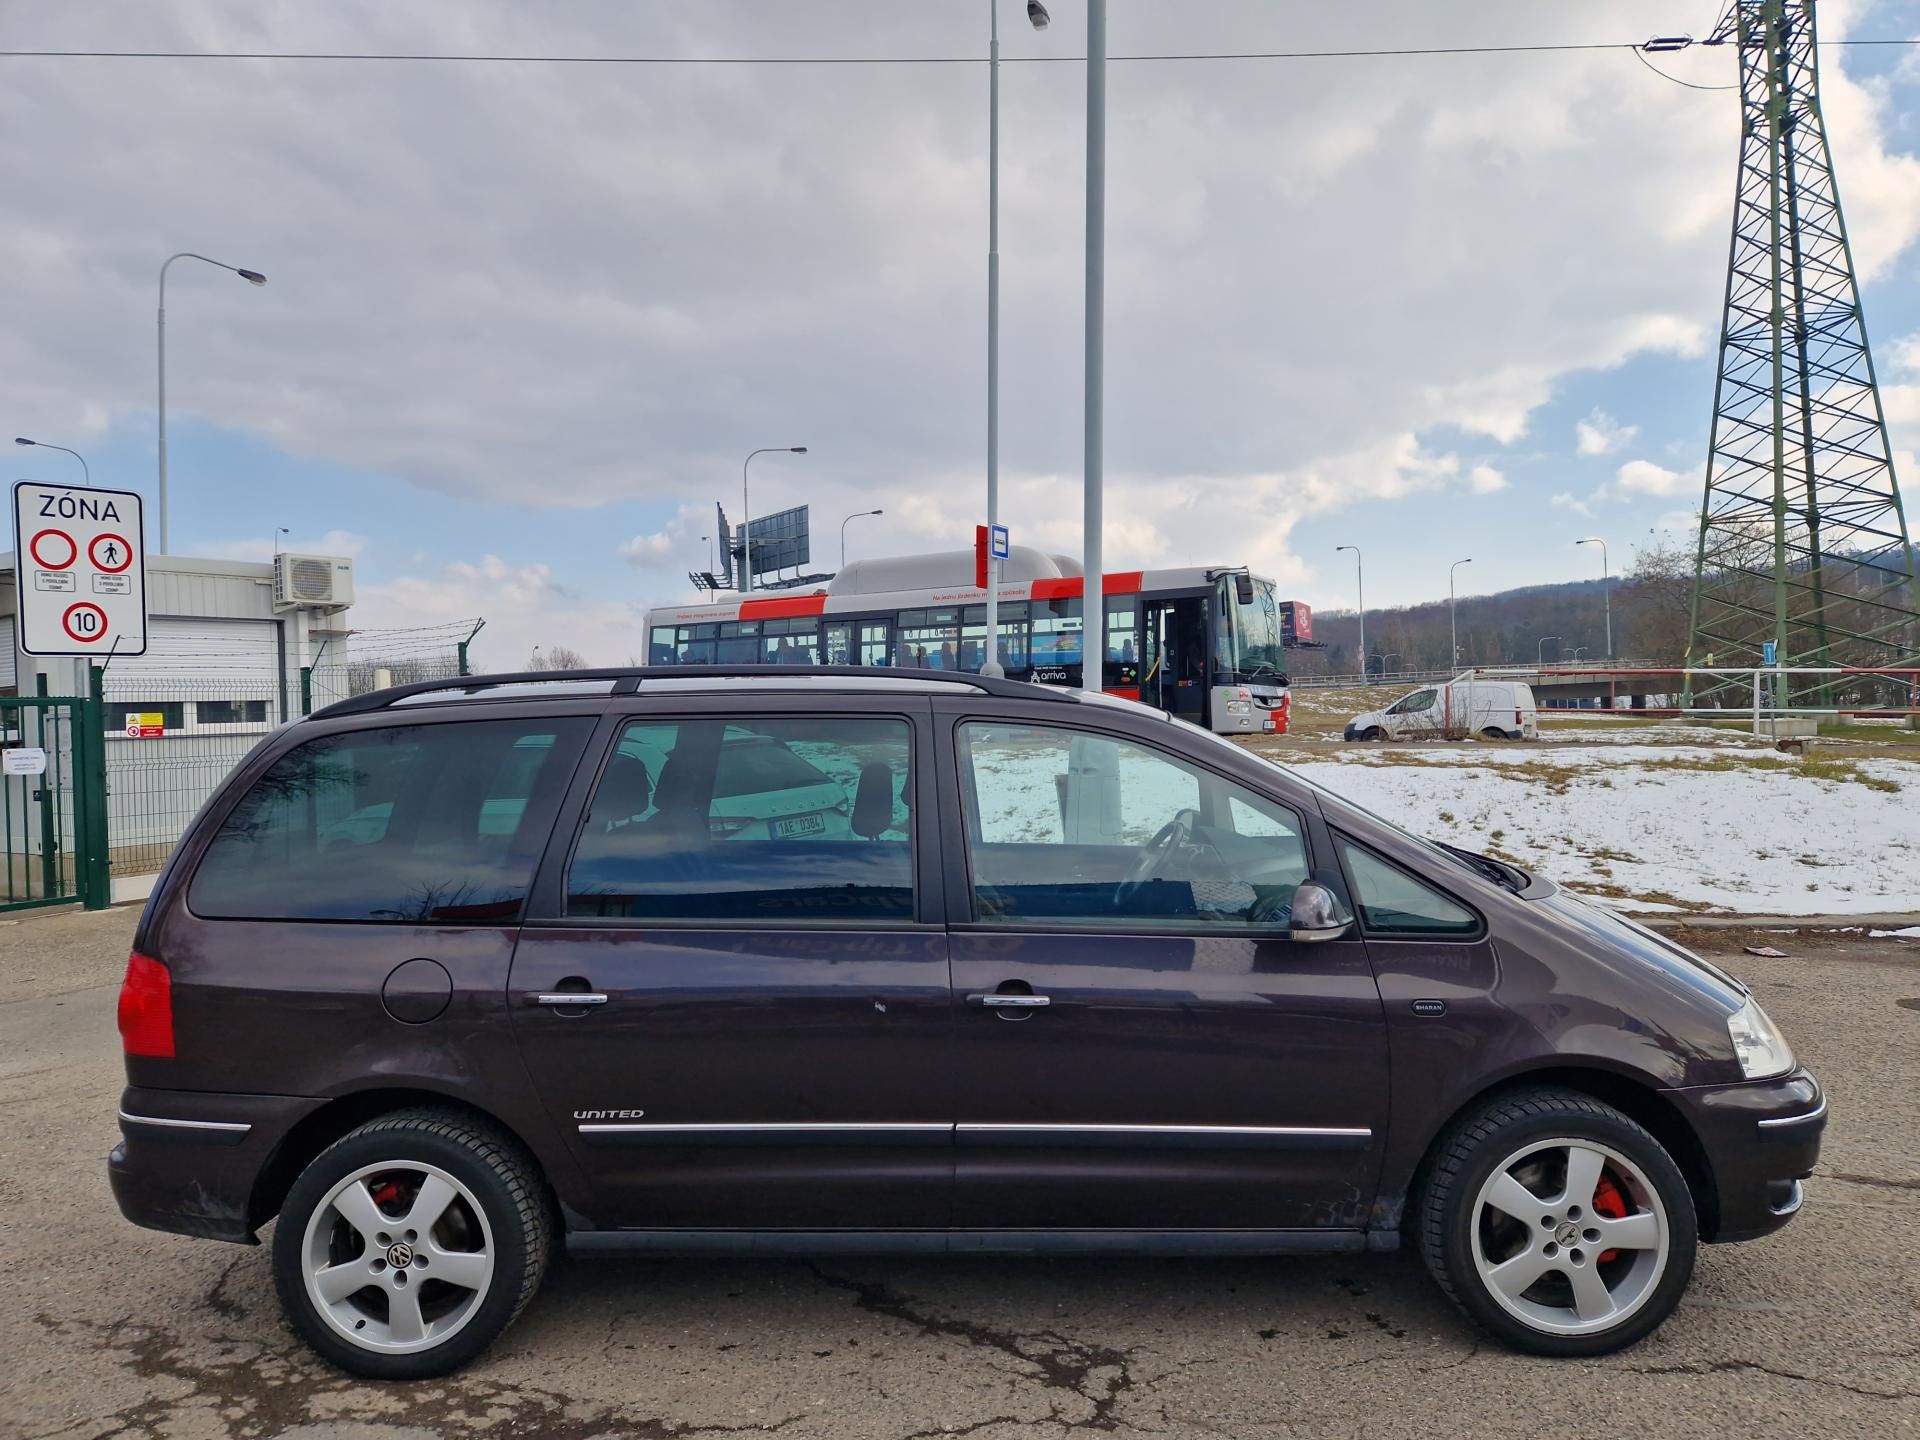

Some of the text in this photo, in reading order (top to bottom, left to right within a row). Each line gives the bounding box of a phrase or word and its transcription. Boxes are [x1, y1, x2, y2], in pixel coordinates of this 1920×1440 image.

[39, 491, 120, 523] ZÓNA
[74, 612, 96, 632] 10
[1041, 670, 1067, 680] arriva
[573, 1109, 645, 1119] UNITED
